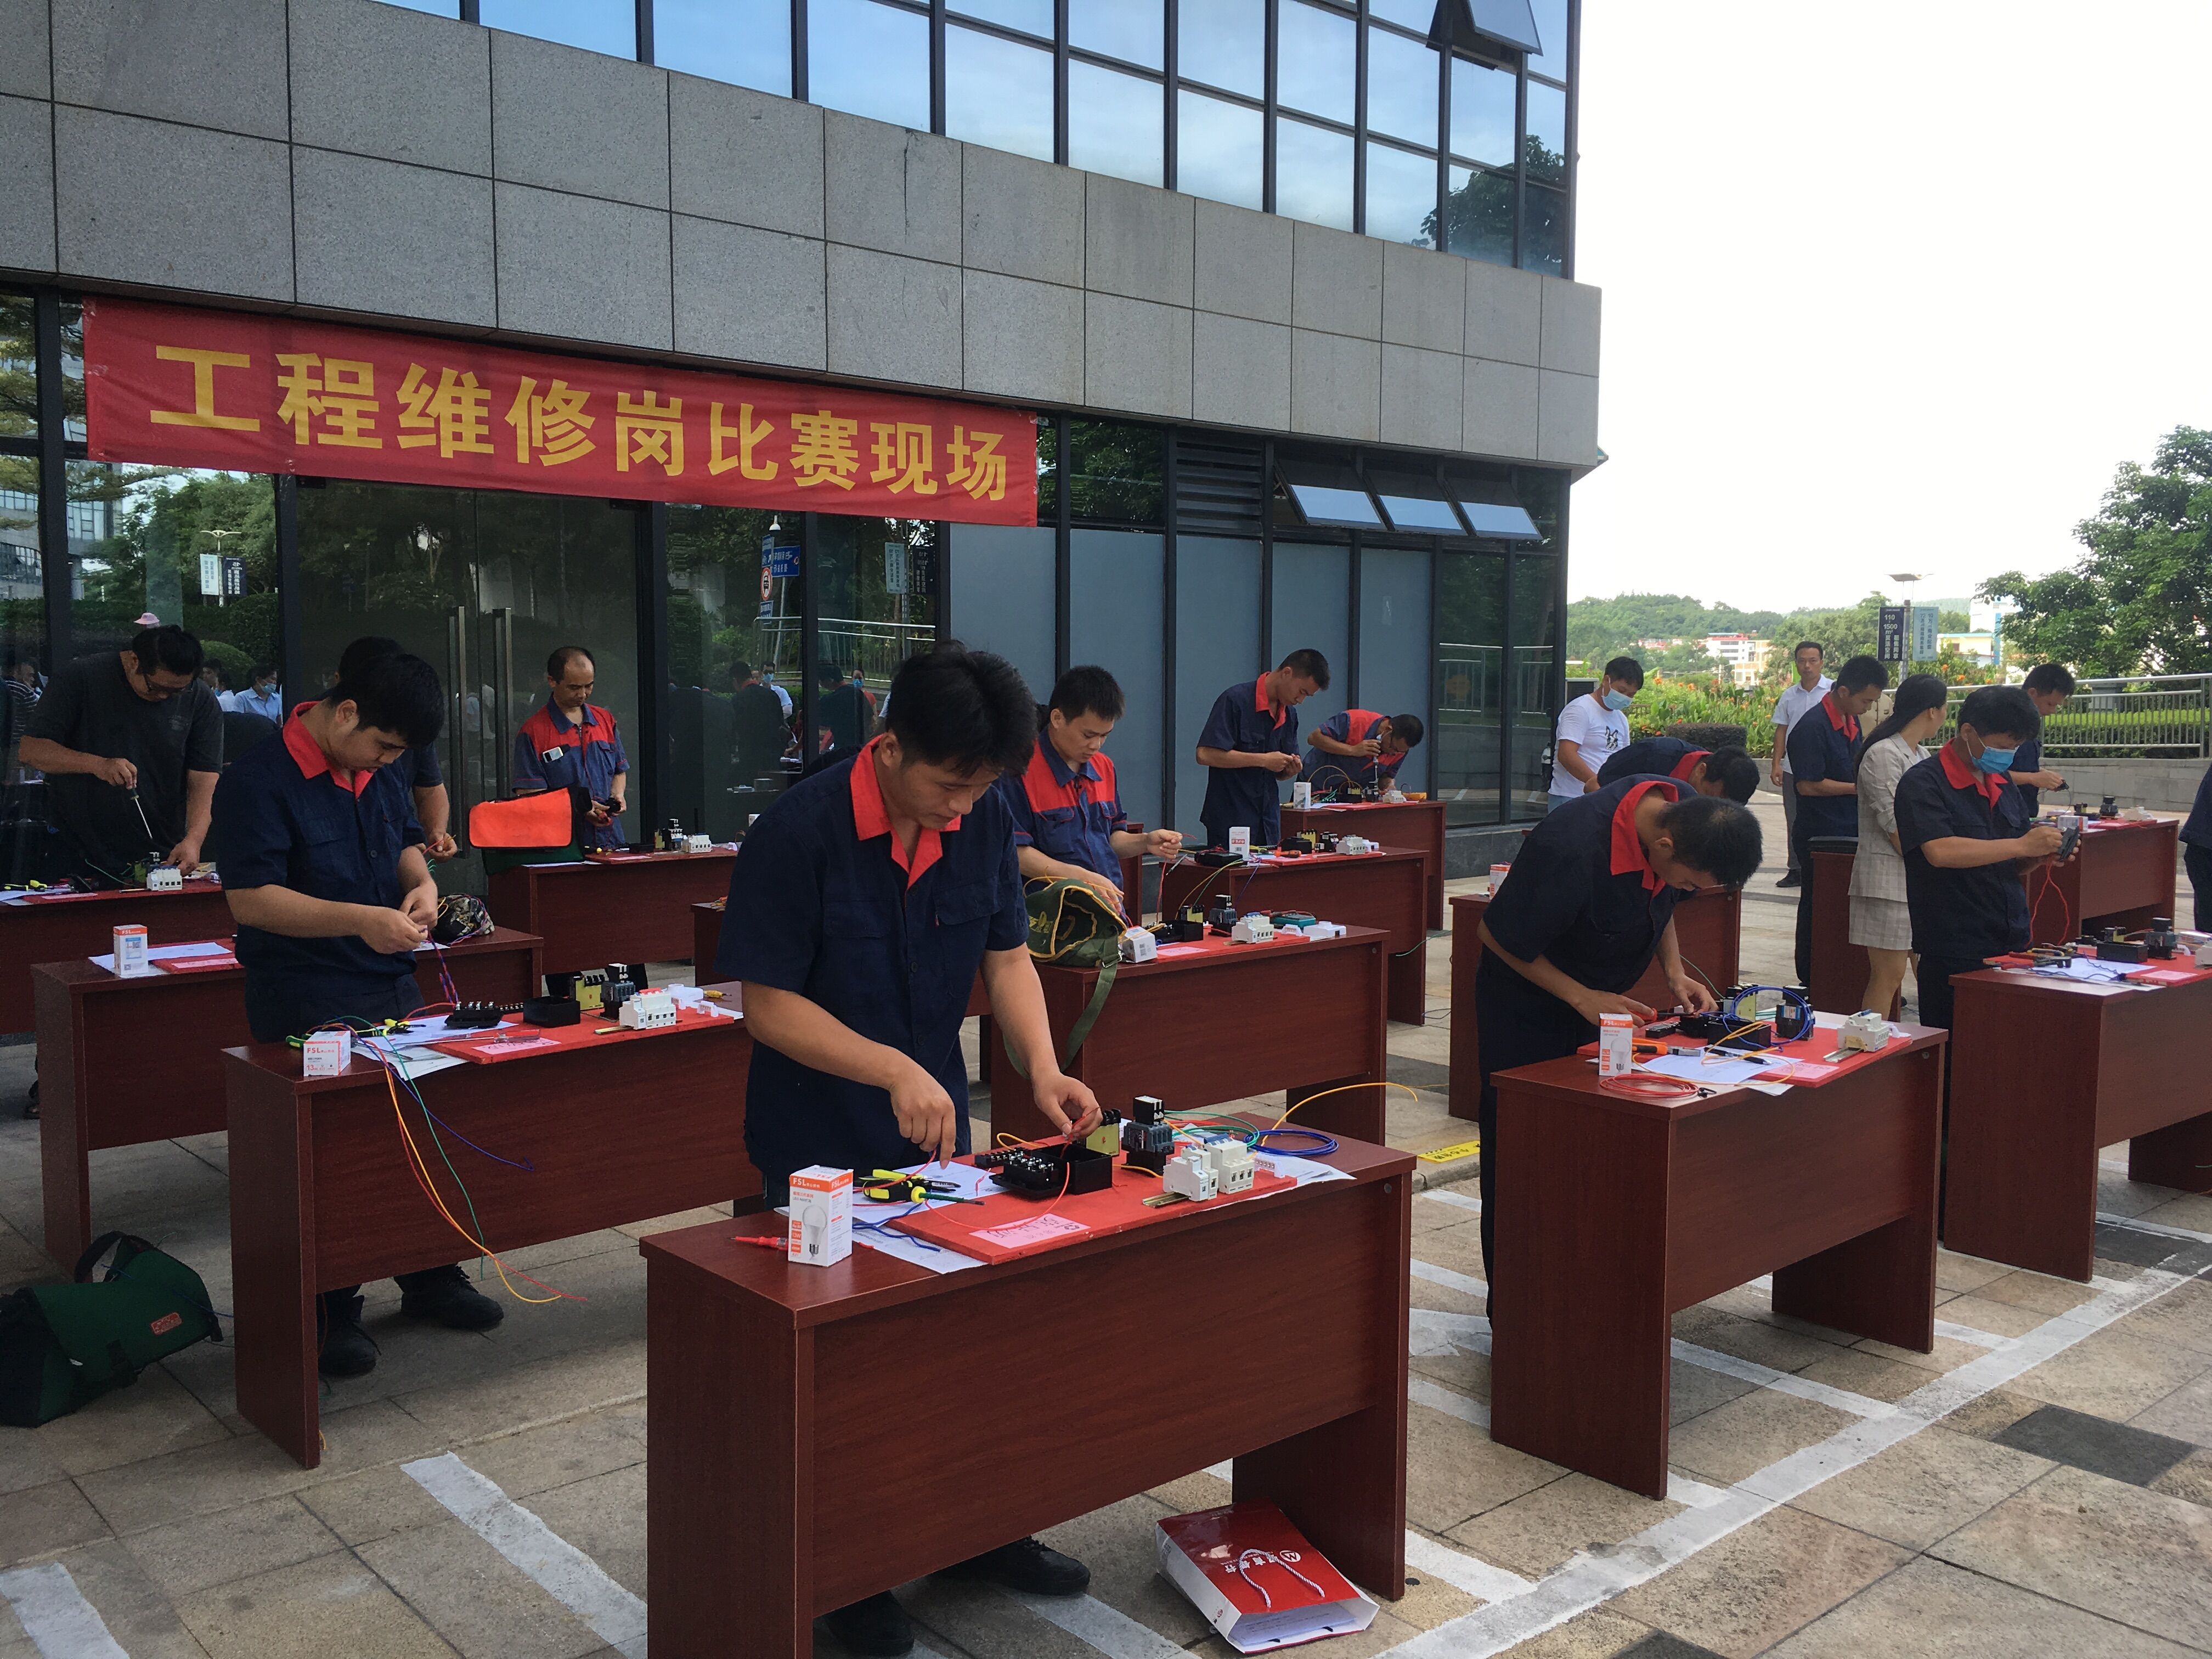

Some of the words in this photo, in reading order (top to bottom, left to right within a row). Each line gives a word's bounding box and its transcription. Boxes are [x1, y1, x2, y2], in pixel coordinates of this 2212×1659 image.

[149, 344, 1008, 501] 工程维修岗比赛现场
[793, 1177, 807, 1186] FSL
[831, 1179, 840, 1189] FSL
